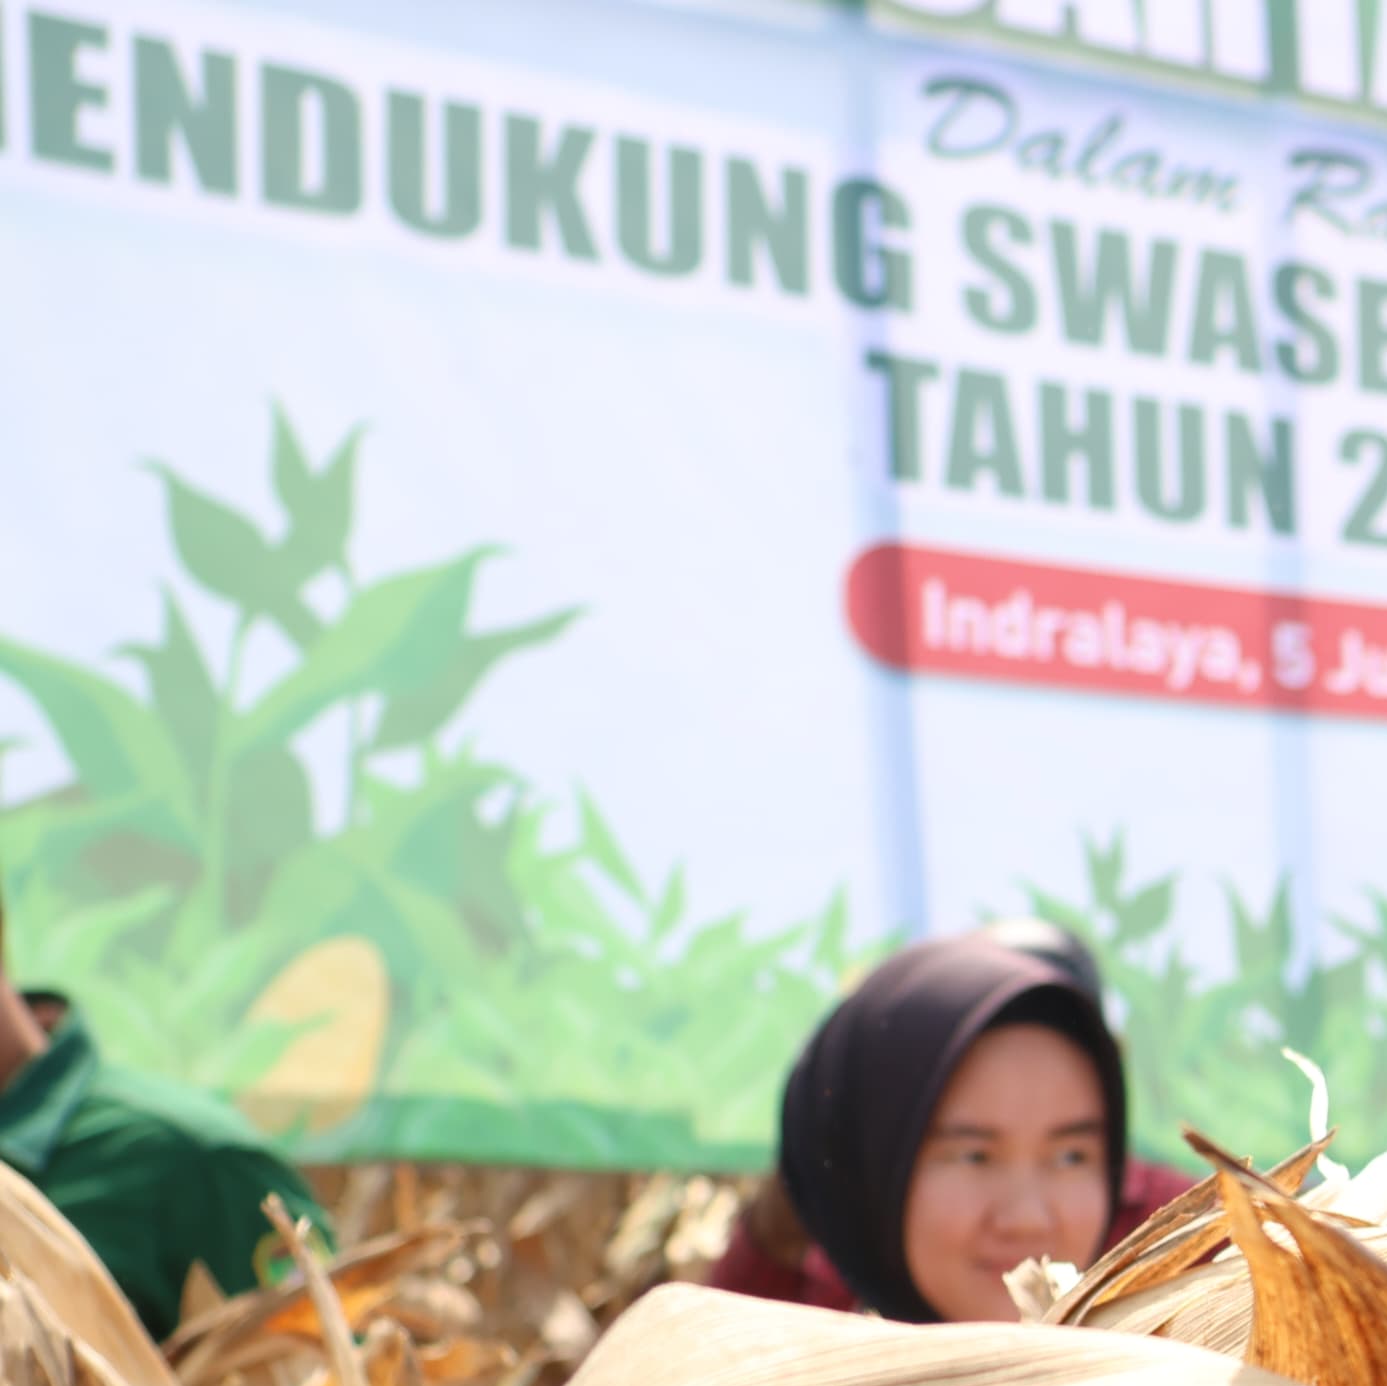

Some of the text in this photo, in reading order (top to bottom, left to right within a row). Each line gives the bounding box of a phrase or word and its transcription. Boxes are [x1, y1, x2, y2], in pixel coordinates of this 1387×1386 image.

[0, 2, 914, 316] ENDUKUNG
[921, 73, 1239, 217] Dalam
[866, 349, 1297, 536] TAHUN
[920, 576, 1260, 694] Indralaya,
[1271, 620, 1315, 690] 5
